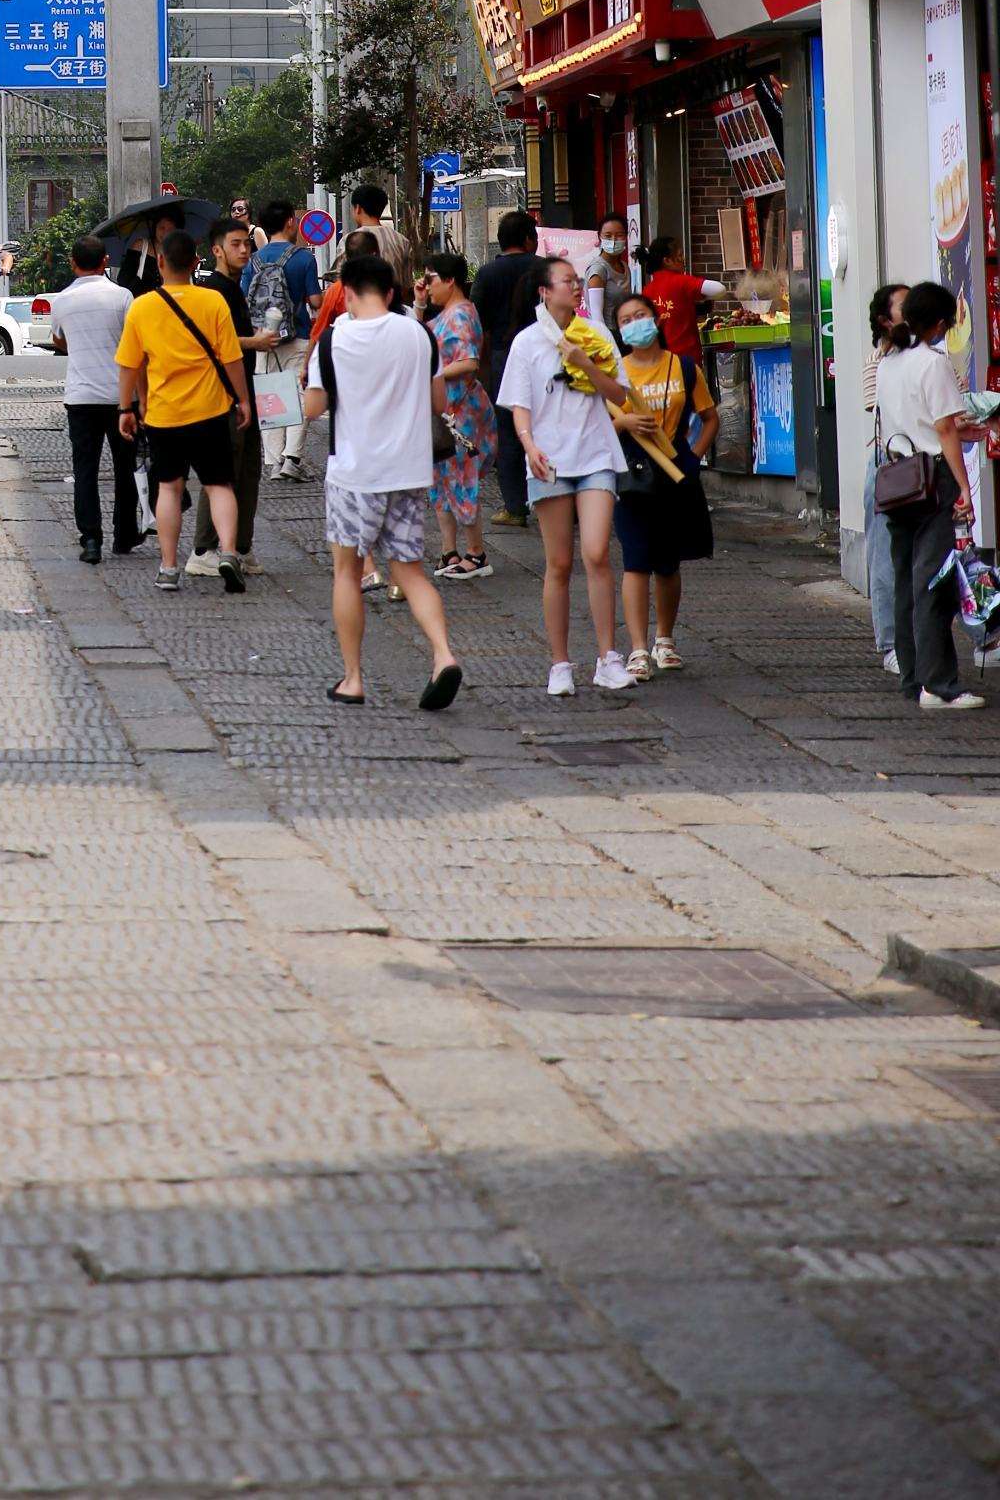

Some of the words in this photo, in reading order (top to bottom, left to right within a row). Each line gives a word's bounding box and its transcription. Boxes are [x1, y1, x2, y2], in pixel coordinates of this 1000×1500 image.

[51, 7, 81, 15] Renmin
[84, 7, 96, 15] Rd.
[4, 21, 70, 40] 三王街
[9, 43, 49, 52] Sanwang
[53, 42, 67, 51] Jie
[57, 60, 104, 76] 坡子街
